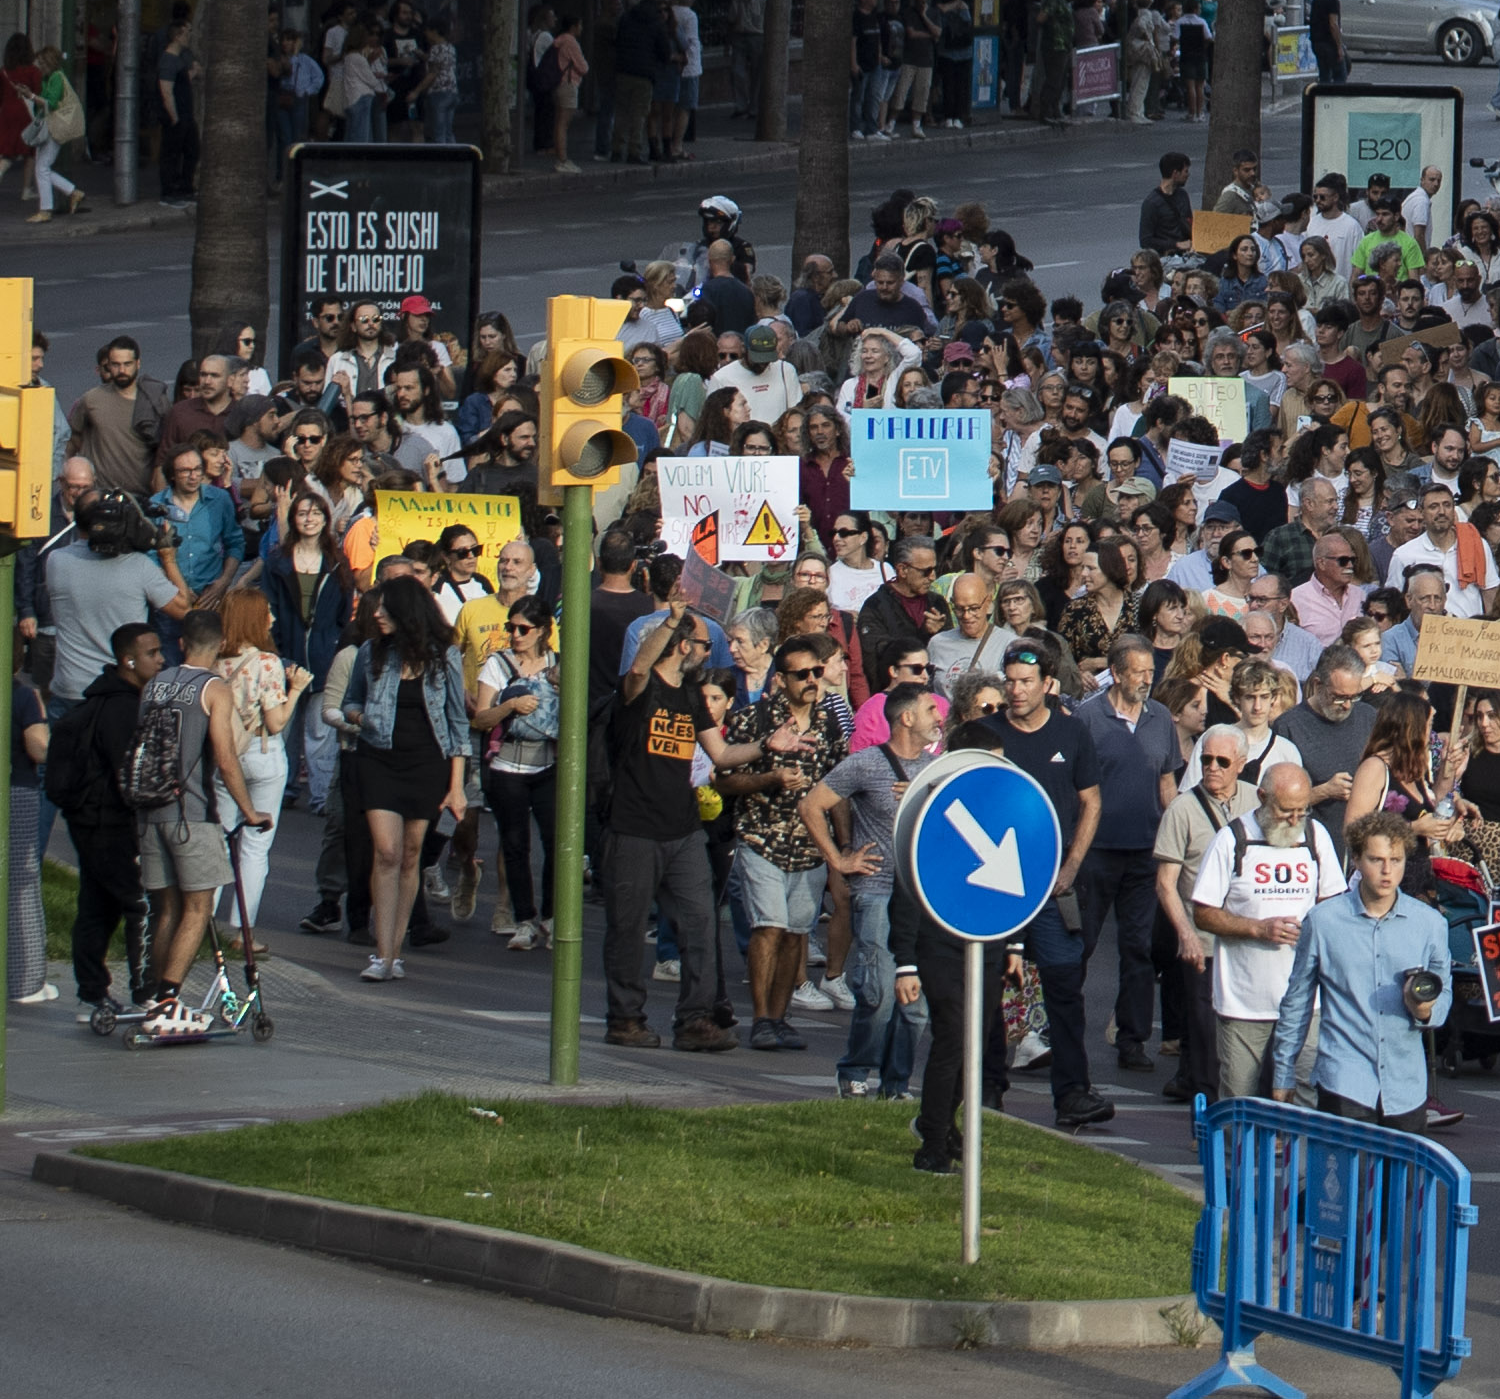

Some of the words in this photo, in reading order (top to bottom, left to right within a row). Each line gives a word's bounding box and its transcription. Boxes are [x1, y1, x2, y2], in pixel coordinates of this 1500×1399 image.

[1358, 138, 1412, 161] B20
[307, 211, 349, 250] ESTO
[357, 211, 378, 250] ES
[385, 211, 439, 250] SUSHI
[305, 254, 327, 293] DE
[335, 254, 424, 293] CANGREJO
[867, 417, 982, 440] MALLORCA
[664, 464, 714, 487] VOLEM
[907, 456, 942, 480] ETV
[683, 494, 712, 516] NO
[676, 724, 693, 738] ES
[652, 738, 680, 754] VEN
[1254, 862, 1309, 884] SOS
